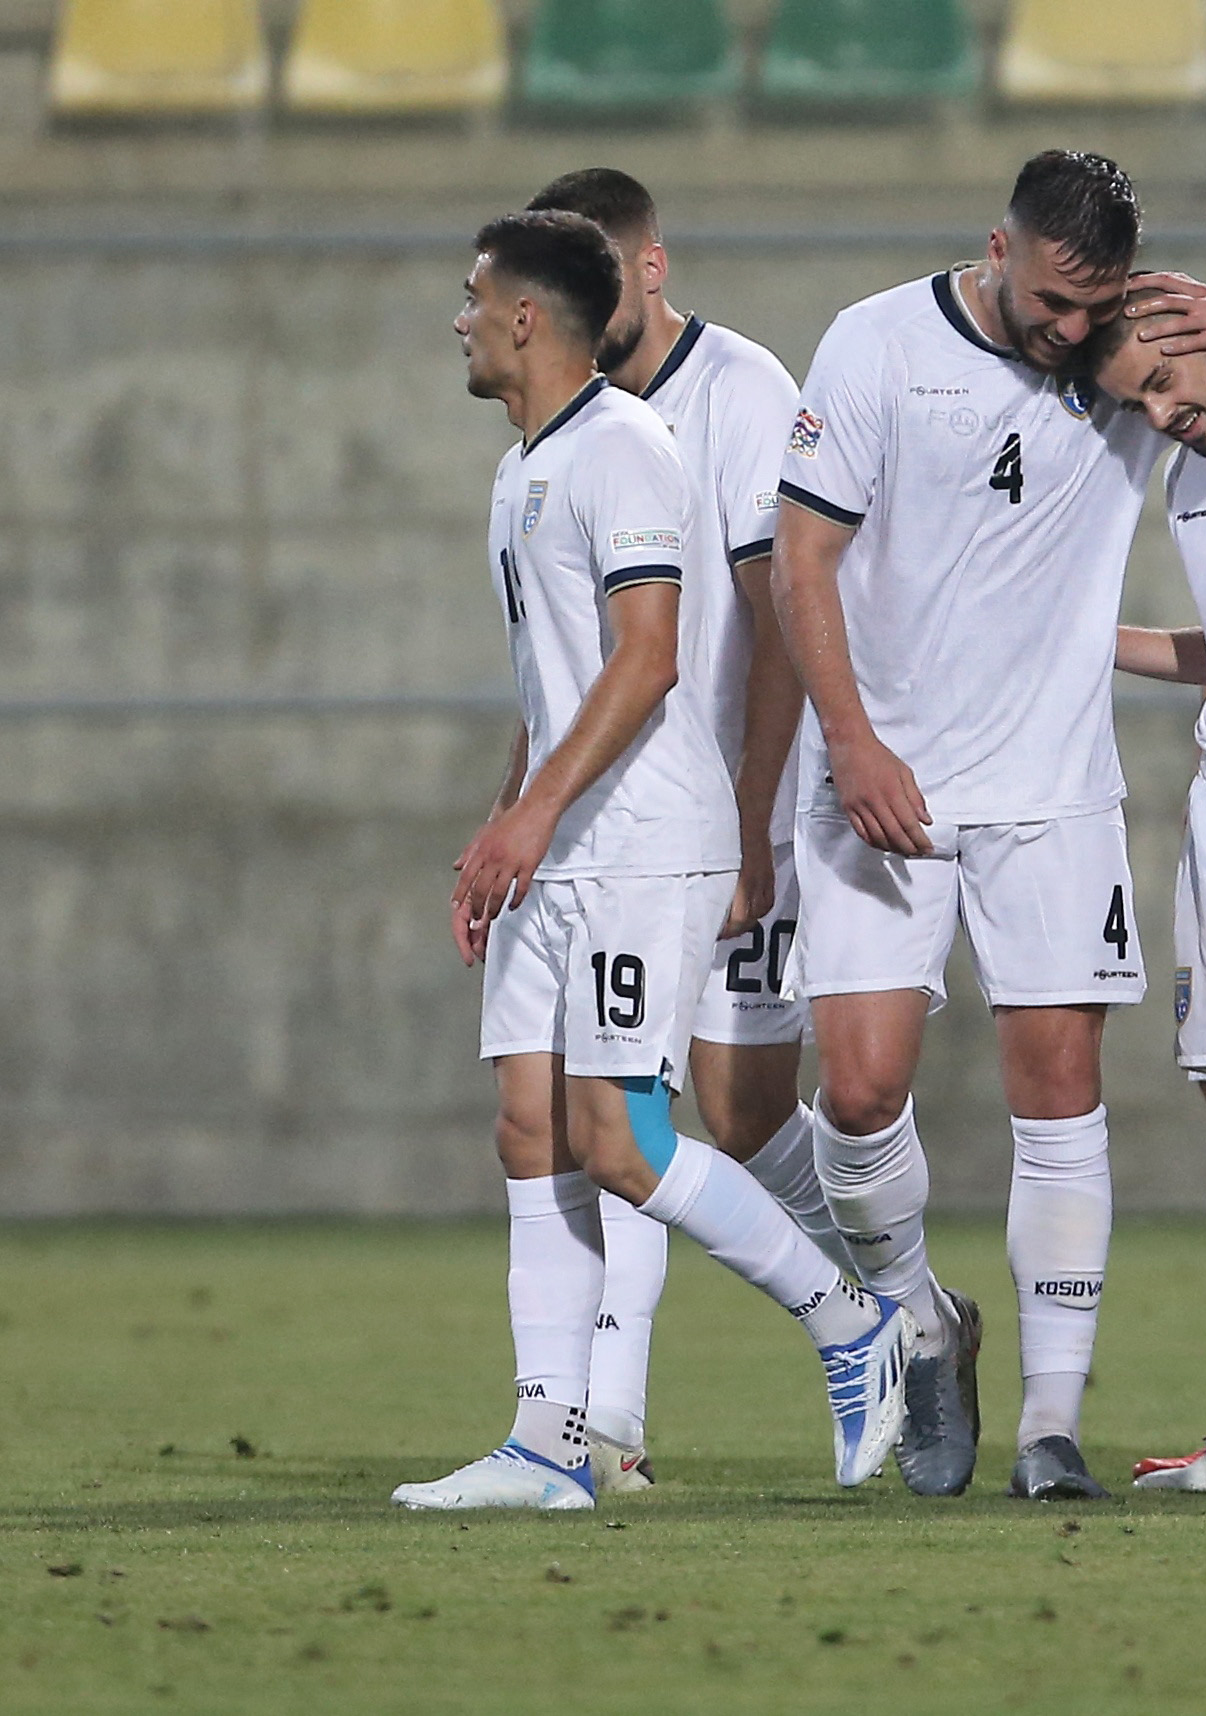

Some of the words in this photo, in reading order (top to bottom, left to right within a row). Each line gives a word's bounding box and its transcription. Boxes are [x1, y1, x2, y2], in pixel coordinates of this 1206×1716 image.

[989, 433, 1023, 504] 4
[726, 919, 797, 995] 20
[1103, 885, 1129, 960] 4
[591, 951, 646, 1029] 19
[517, 1384, 547, 1399] OVA
